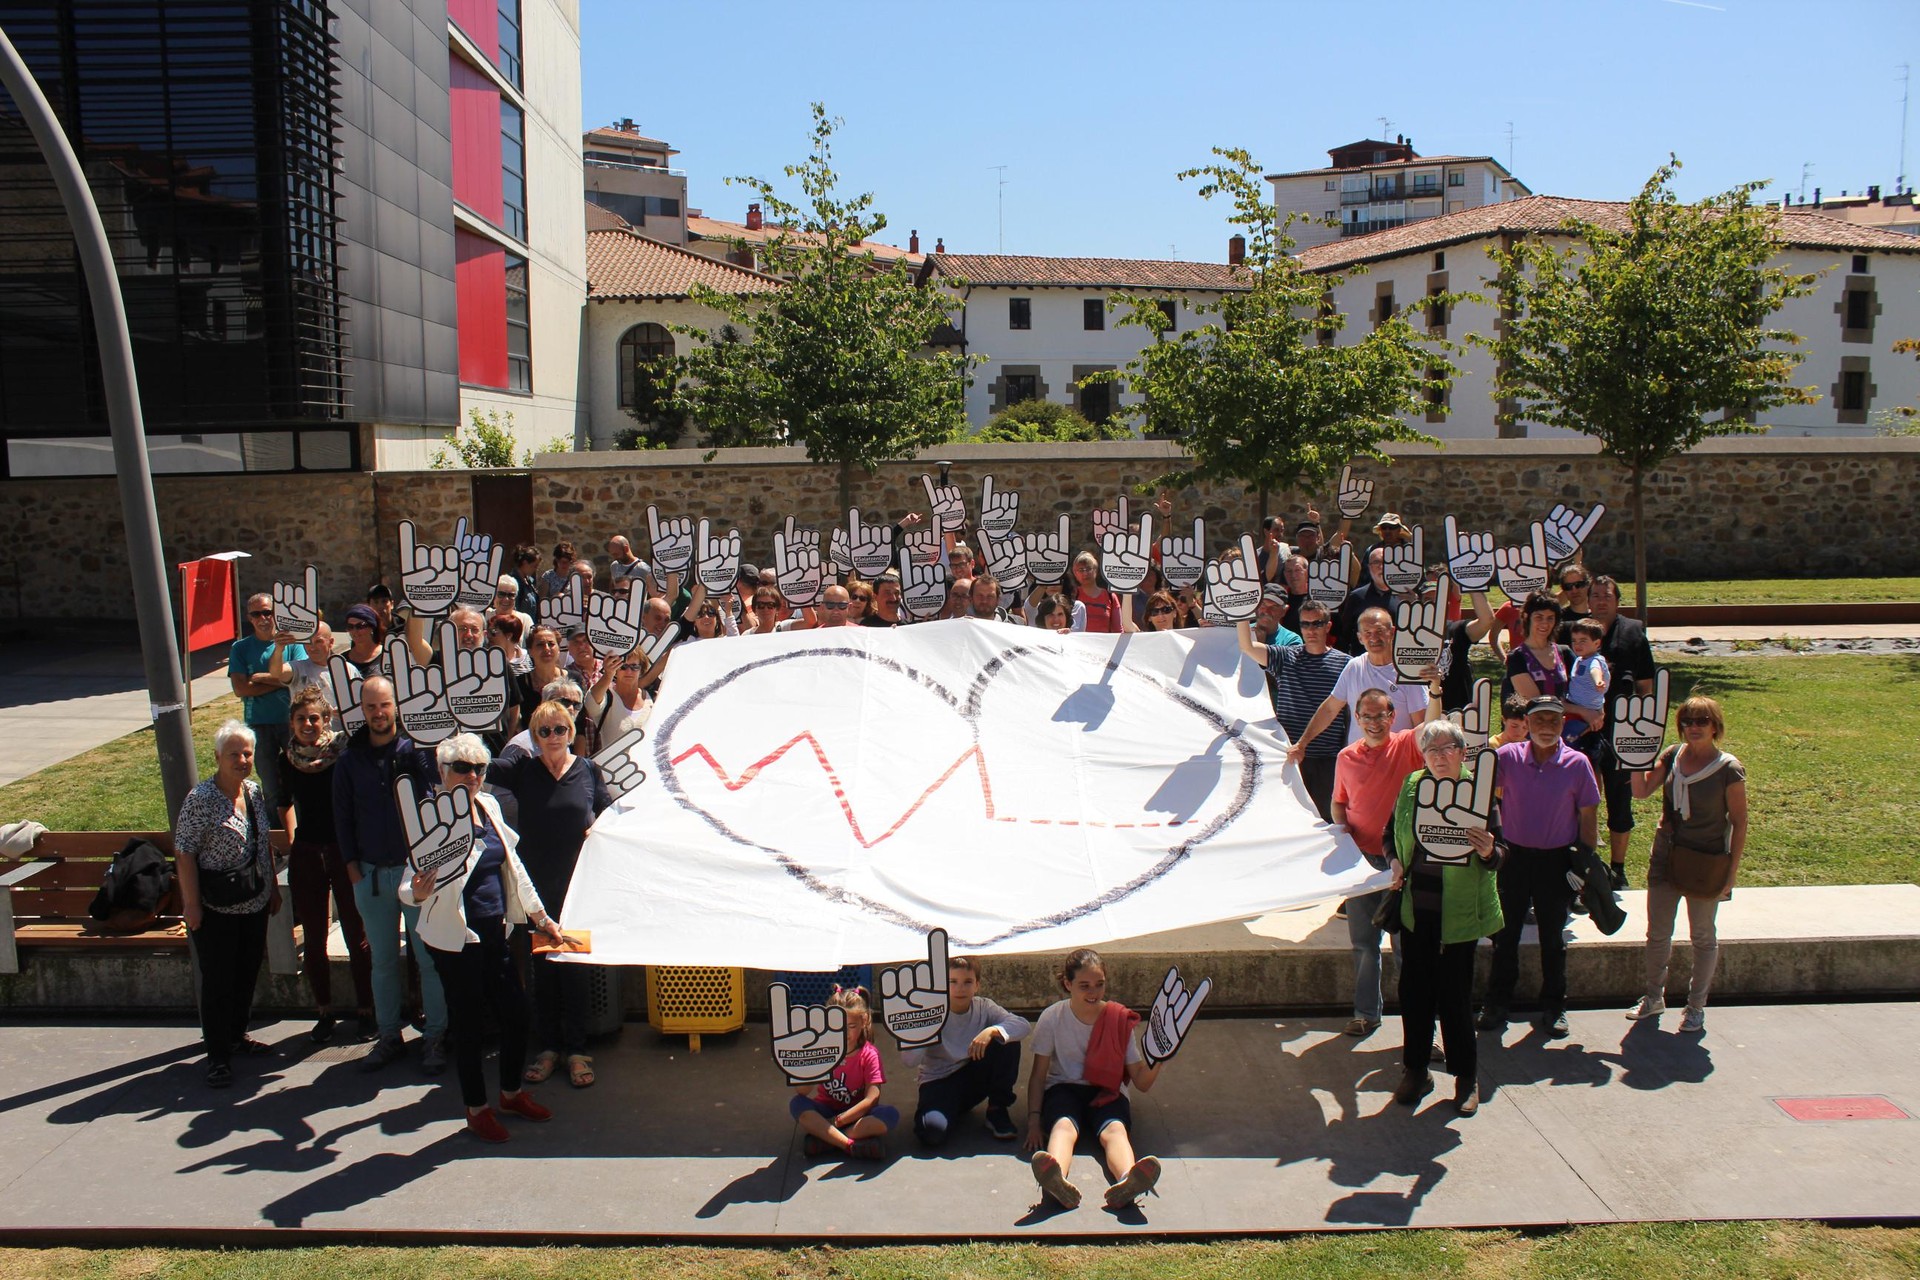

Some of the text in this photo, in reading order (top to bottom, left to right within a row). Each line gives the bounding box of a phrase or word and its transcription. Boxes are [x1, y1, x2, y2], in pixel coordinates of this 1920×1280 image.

[1105, 565, 1146, 574] #SalatzenDut
[1453, 565, 1493, 573] #SalatzenDut
[1503, 577, 1545, 587] #SalatzenDut
[1216, 590, 1260, 602] #SalatzenDut
[590, 630, 634, 642] #SalatzenDut
[1397, 648, 1439, 656] #SalatzenDut
[451, 694, 503, 705] #SalatzenDut
[455, 705, 500, 714] #YoDenuncio
[404, 711, 453, 722] #SalatzenDu
[408, 720, 456, 731] #YoDenuncio
[1616, 737, 1660, 745] #SalatzenDut
[418, 836, 470, 866] #SalatzenDut
[889, 1005, 944, 1022] #SalatzenDut
[893, 1017, 942, 1031] #YoDenuncio
[779, 1047, 840, 1058] #SalatzenDut
[783, 1056, 836, 1067] #YoDenuncio
